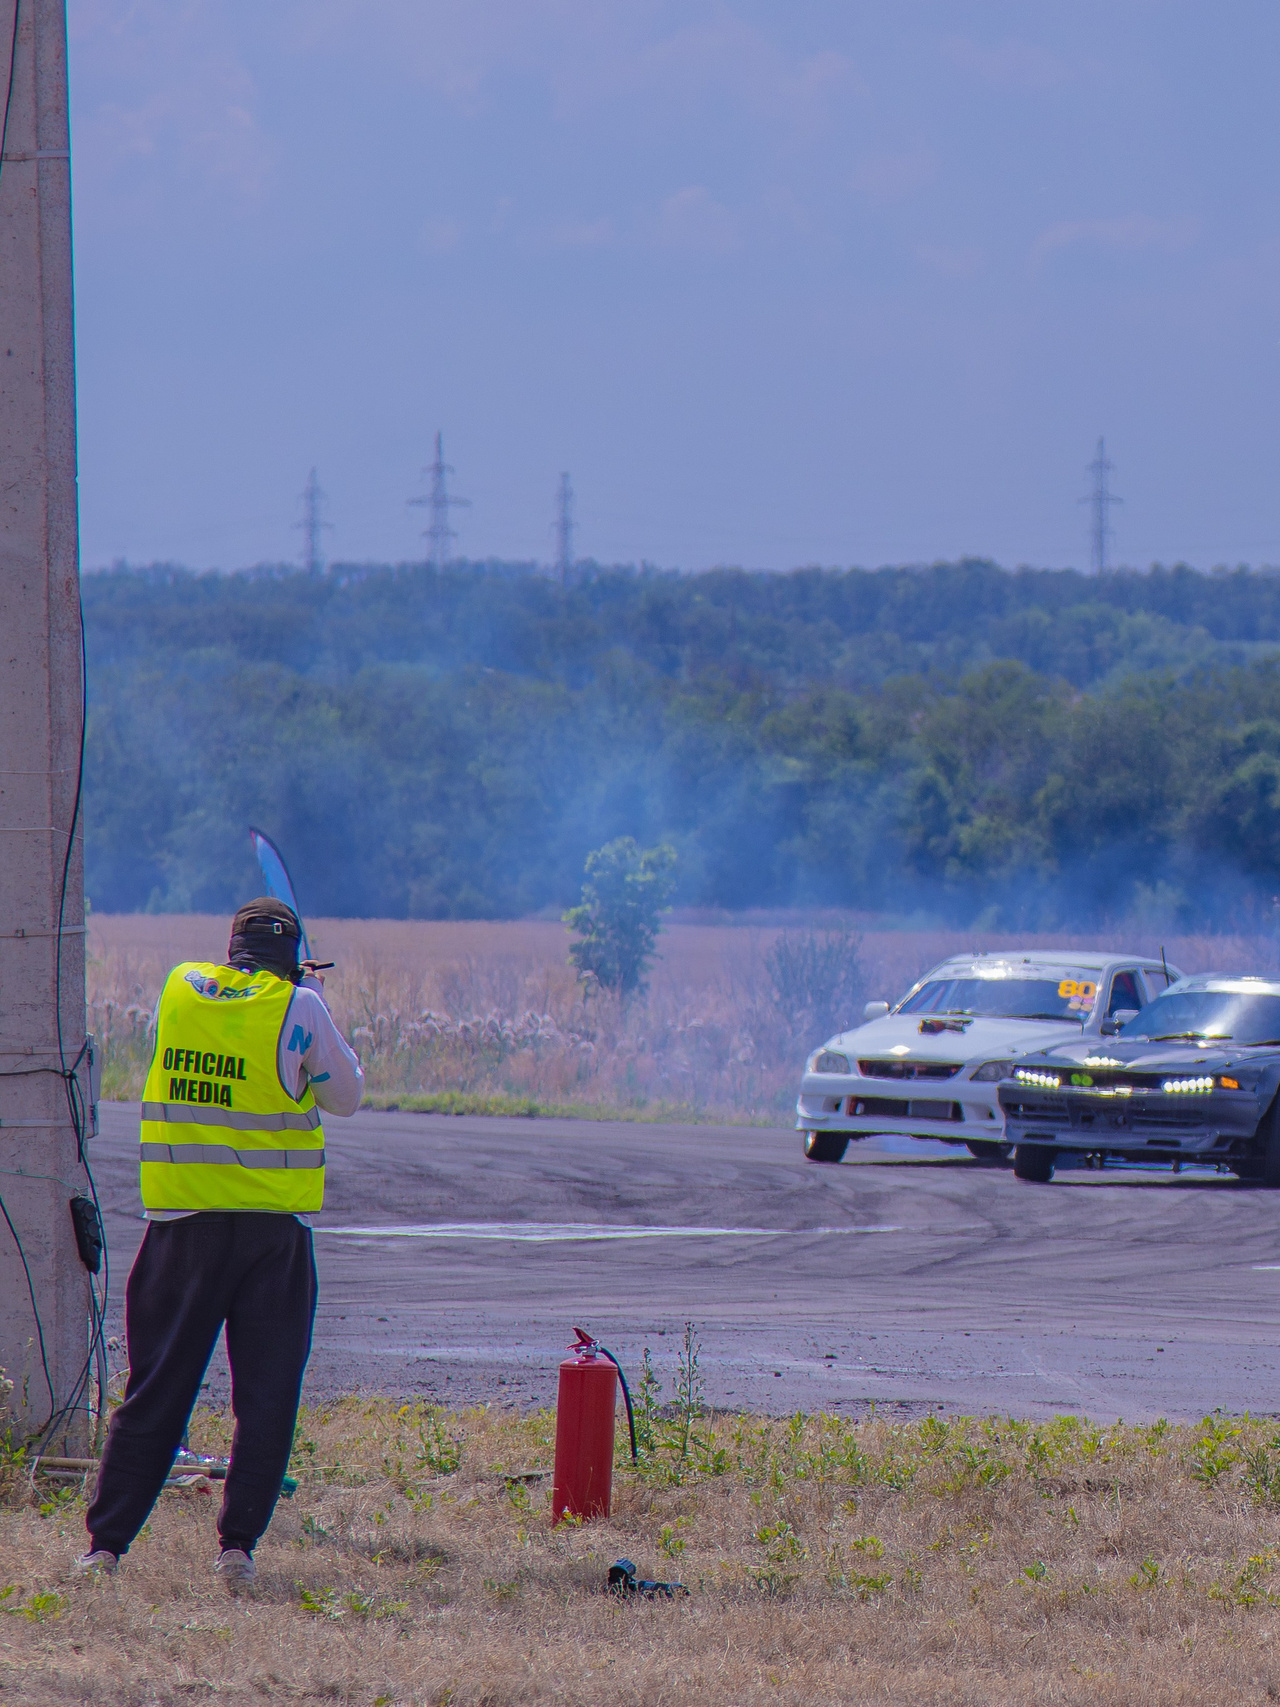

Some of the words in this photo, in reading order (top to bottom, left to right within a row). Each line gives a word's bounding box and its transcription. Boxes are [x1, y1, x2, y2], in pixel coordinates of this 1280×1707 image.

[1058, 980, 1096, 998] 80
[162, 1047, 247, 1081] OFFICIAL
[169, 1077, 232, 1108] MEDIA
